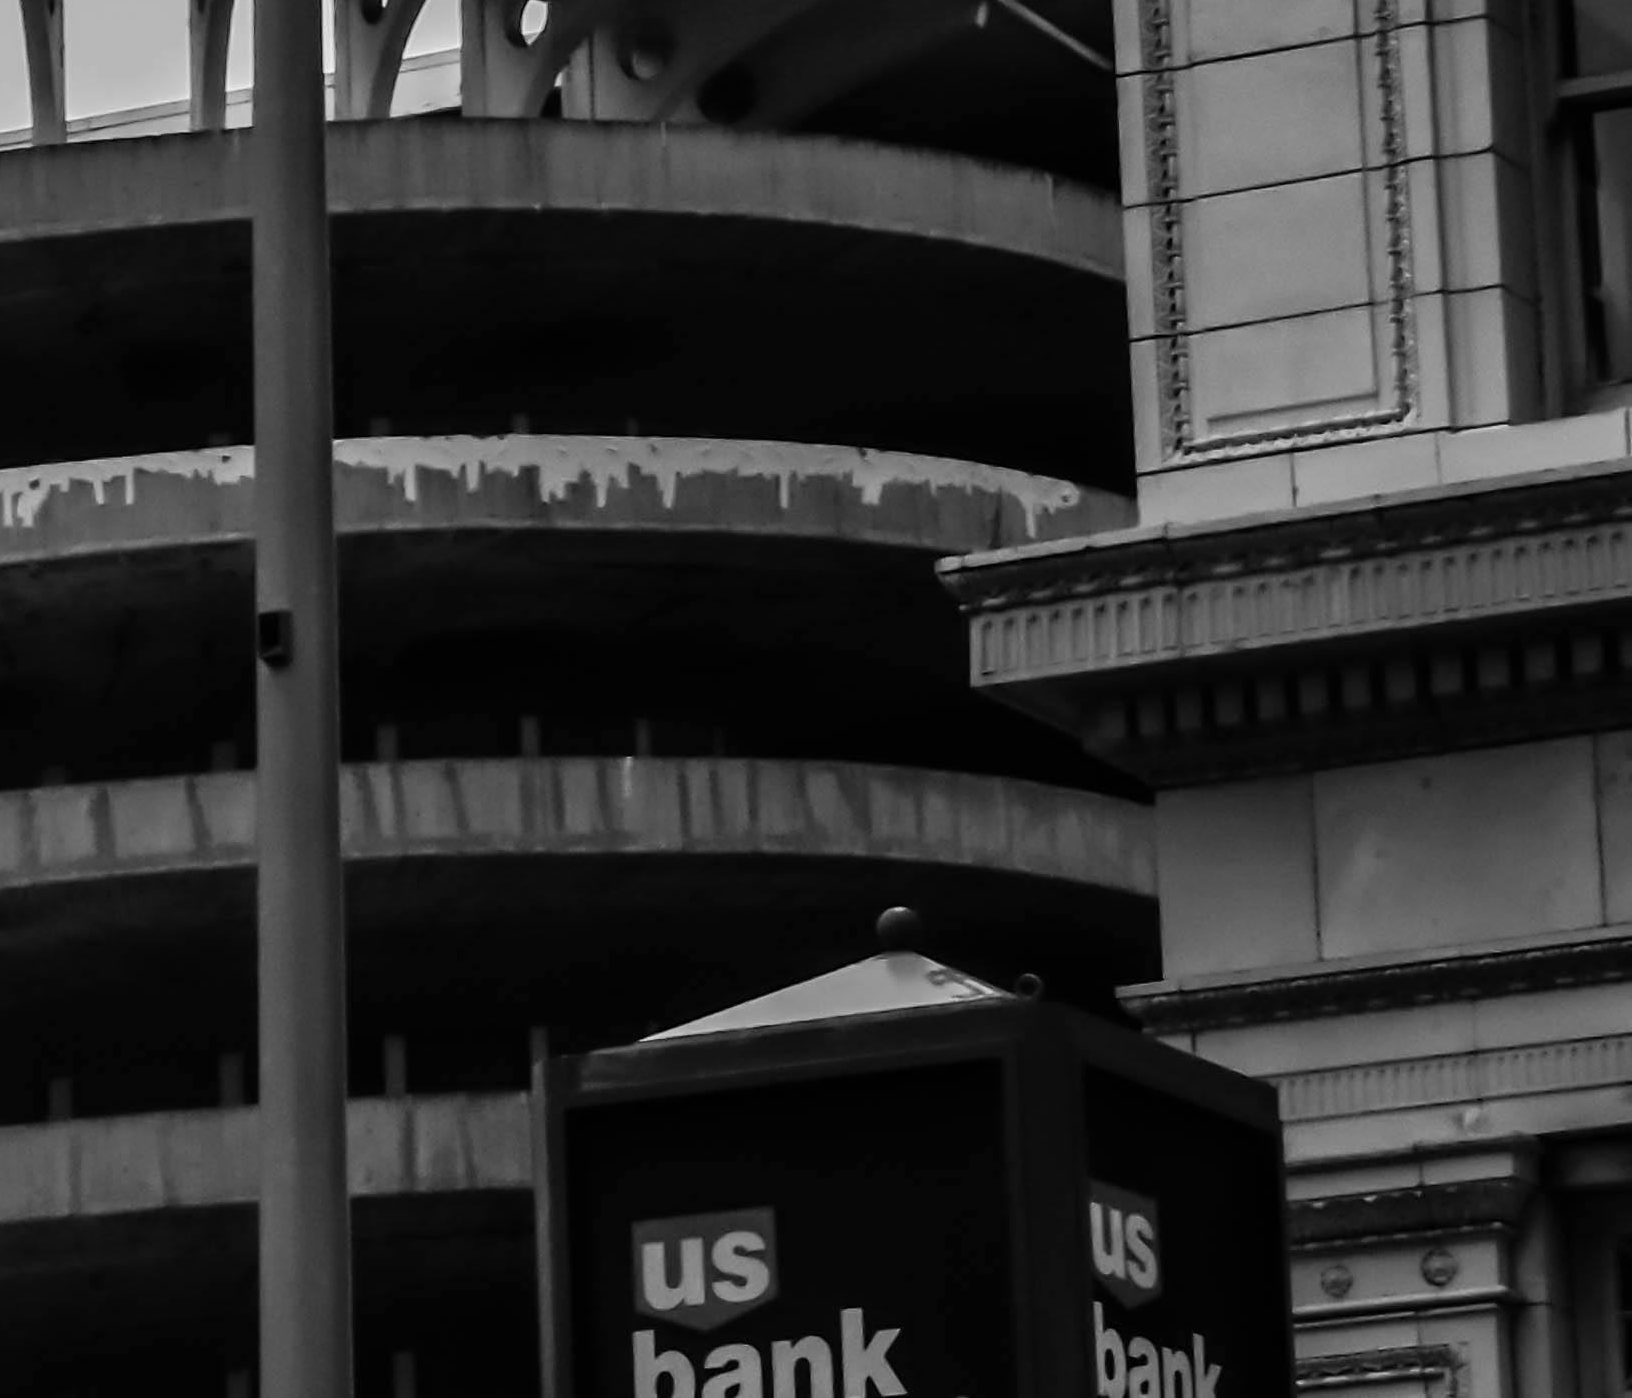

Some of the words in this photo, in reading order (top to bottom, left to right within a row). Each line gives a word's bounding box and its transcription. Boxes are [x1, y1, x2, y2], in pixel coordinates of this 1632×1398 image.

[641, 1230, 771, 1311] us
[1089, 1202, 1159, 1290] us
[632, 1306, 909, 1398] bank
[1093, 1301, 1223, 1398] bank
